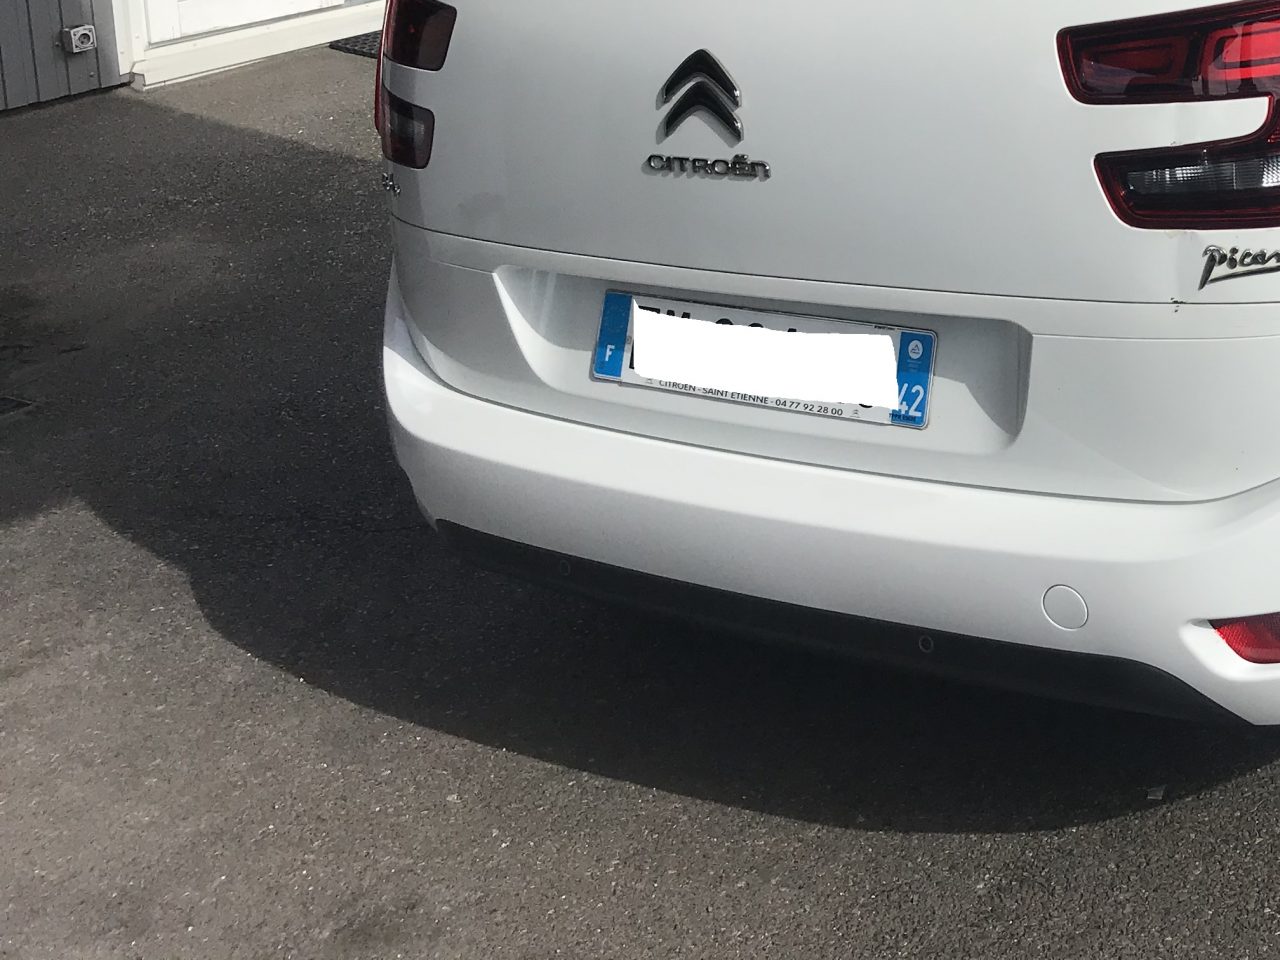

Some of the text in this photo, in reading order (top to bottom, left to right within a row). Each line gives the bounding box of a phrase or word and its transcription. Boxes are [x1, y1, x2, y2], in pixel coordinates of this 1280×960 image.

[604, 344, 616, 362] F
[702, 387, 728, 398] SAINT
[730, 391, 769, 405] ETIENNE
[898, 383, 925, 417] 42
